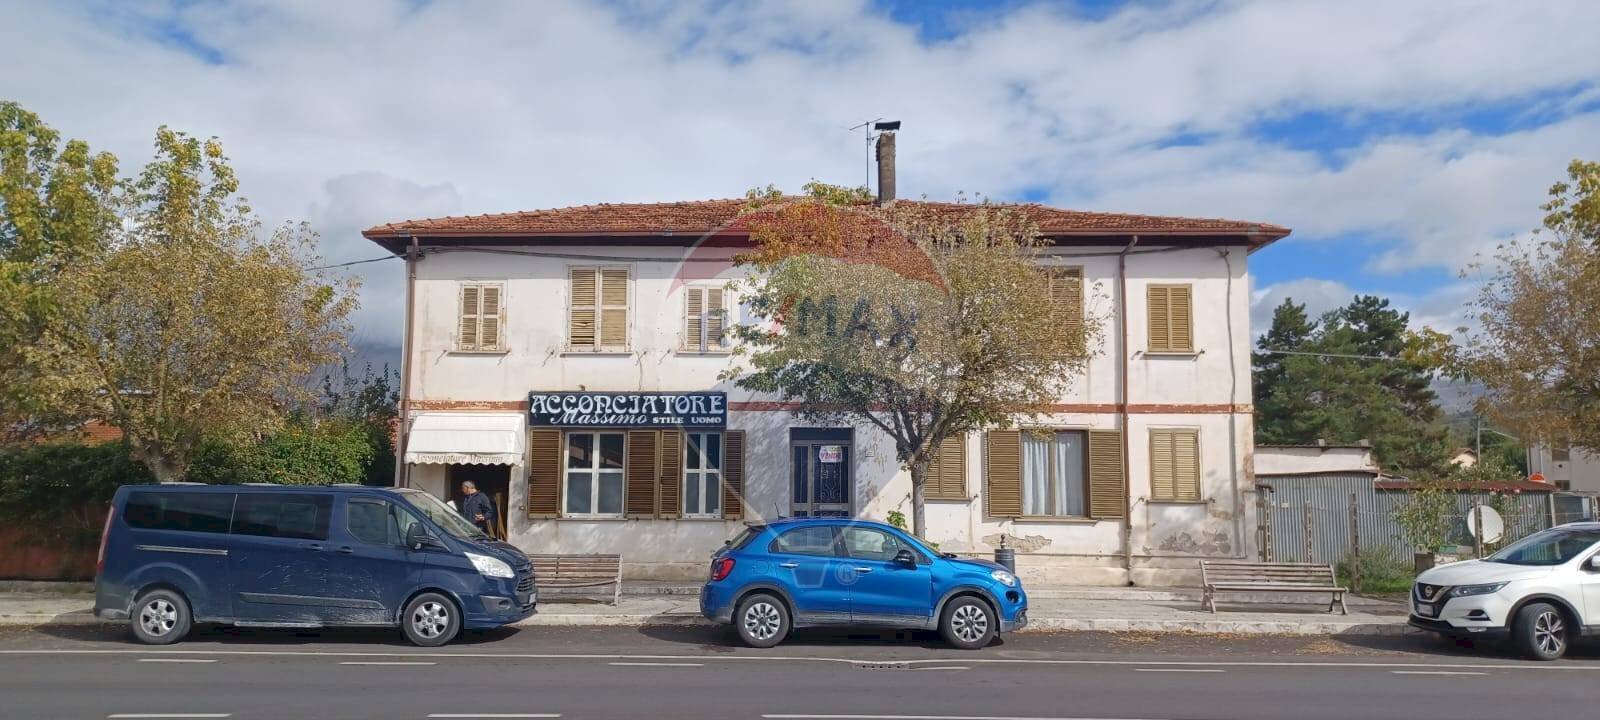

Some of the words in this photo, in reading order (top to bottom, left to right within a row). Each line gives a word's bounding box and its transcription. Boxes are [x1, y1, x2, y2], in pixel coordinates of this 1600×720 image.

[530, 394, 725, 414] ACCONCIATORE
[550, 406, 647, 425] Massimo
[652, 416, 684, 424] STILE
[691, 416, 722, 424] UOMO
